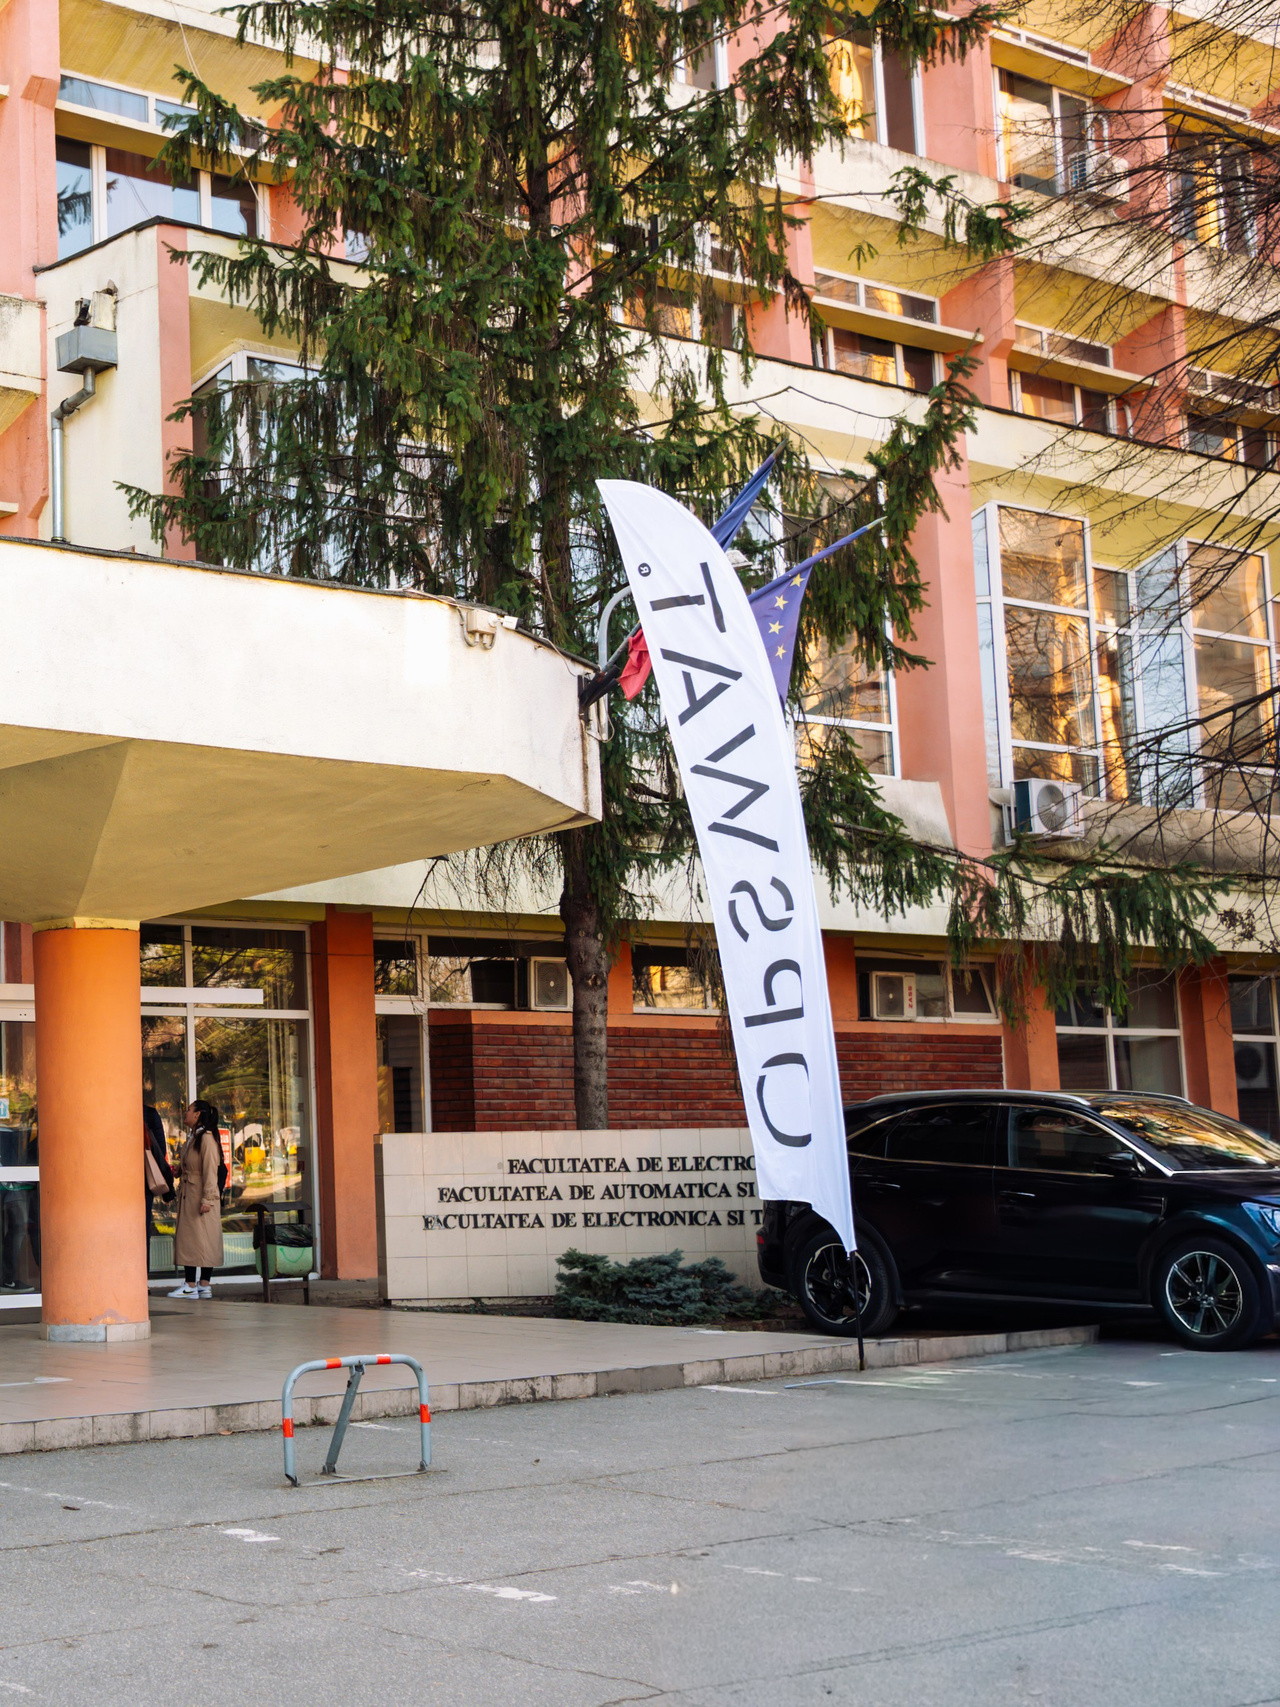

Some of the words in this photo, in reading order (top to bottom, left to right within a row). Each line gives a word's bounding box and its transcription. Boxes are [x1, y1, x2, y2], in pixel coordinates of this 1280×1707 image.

[507, 1157, 632, 1174] FACULTATEA
[636, 1156, 663, 1172] DE
[437, 1185, 563, 1203] FACULTATEA
[568, 1184, 595, 1201] DE
[600, 1182, 732, 1200] AUTOMATICA
[737, 1182, 755, 1198] SI
[422, 1213, 545, 1231] FACULTATEA
[550, 1212, 578, 1229] DE
[582, 1210, 722, 1228] ELECTRONICA
[727, 1210, 745, 1226] SI
